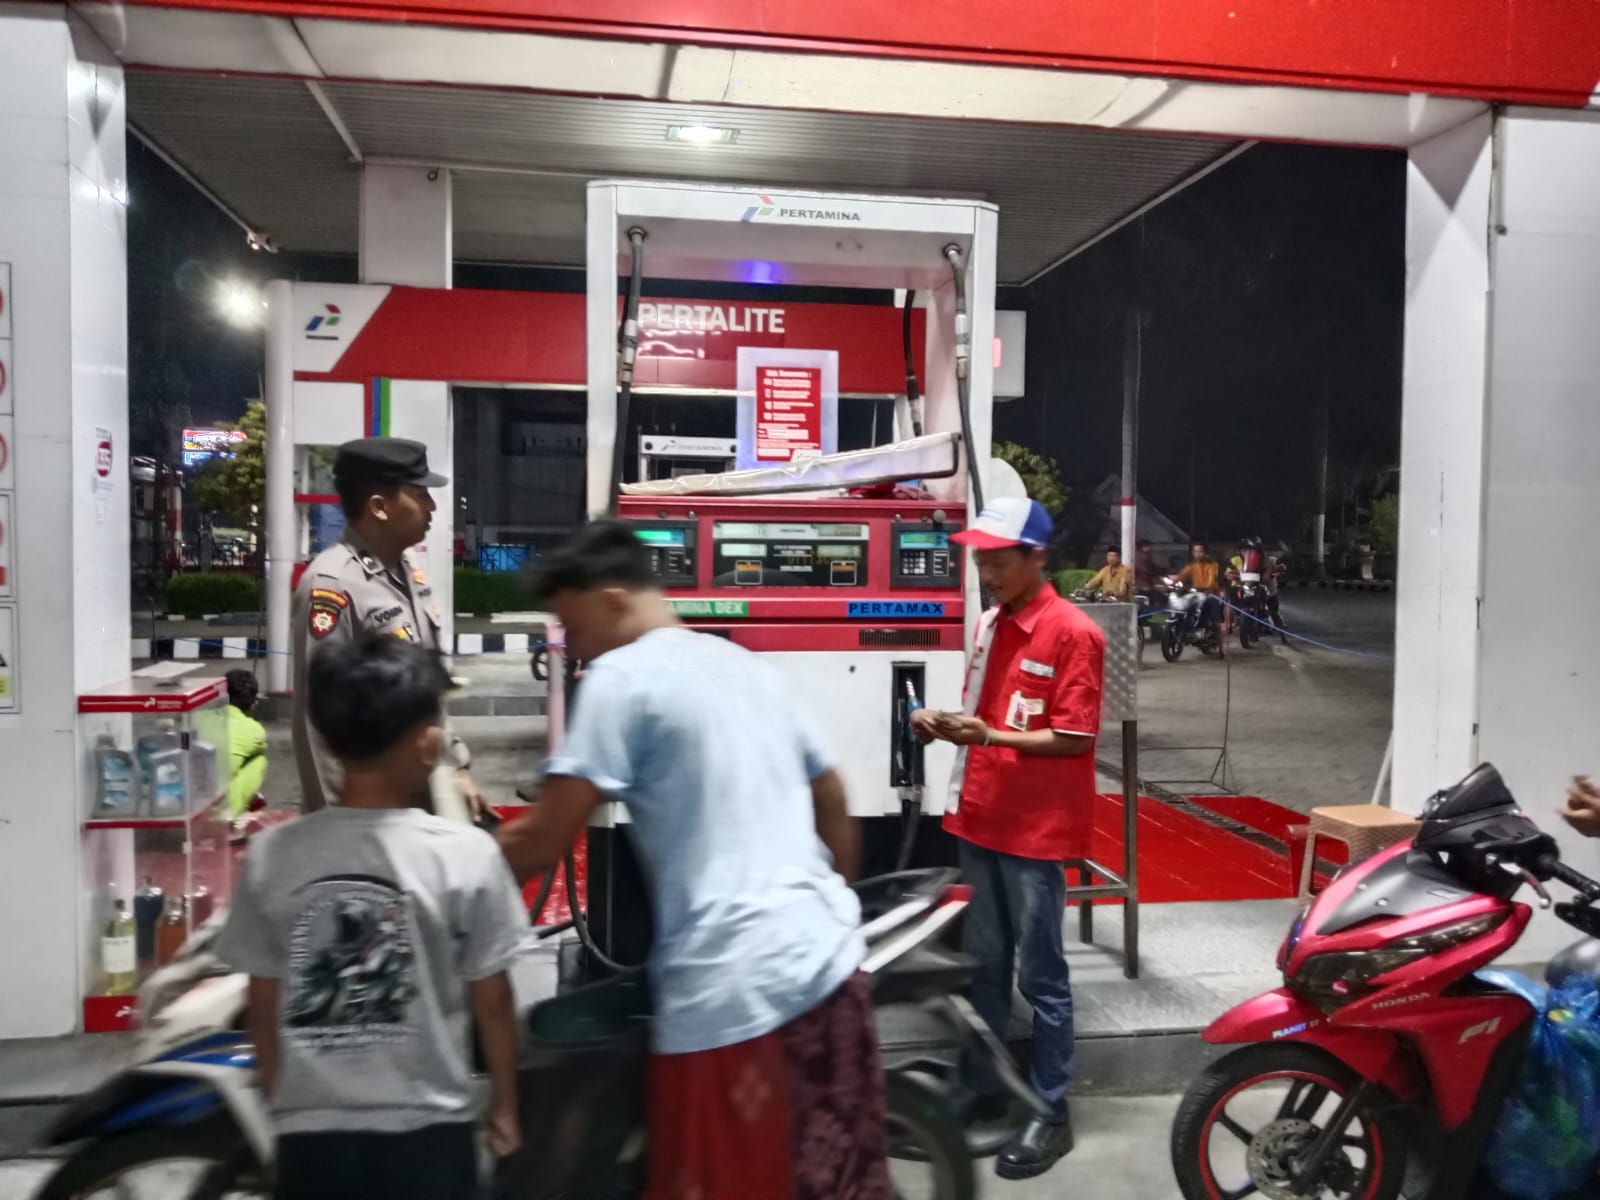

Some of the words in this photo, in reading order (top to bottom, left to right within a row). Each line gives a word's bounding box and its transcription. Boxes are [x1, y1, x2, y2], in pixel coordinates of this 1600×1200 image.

[779, 207, 861, 221] PERTAMINA
[637, 303, 786, 333] PERTALITE
[848, 602, 943, 614] PERTAMAX
[1371, 991, 1432, 1010] HONDA
